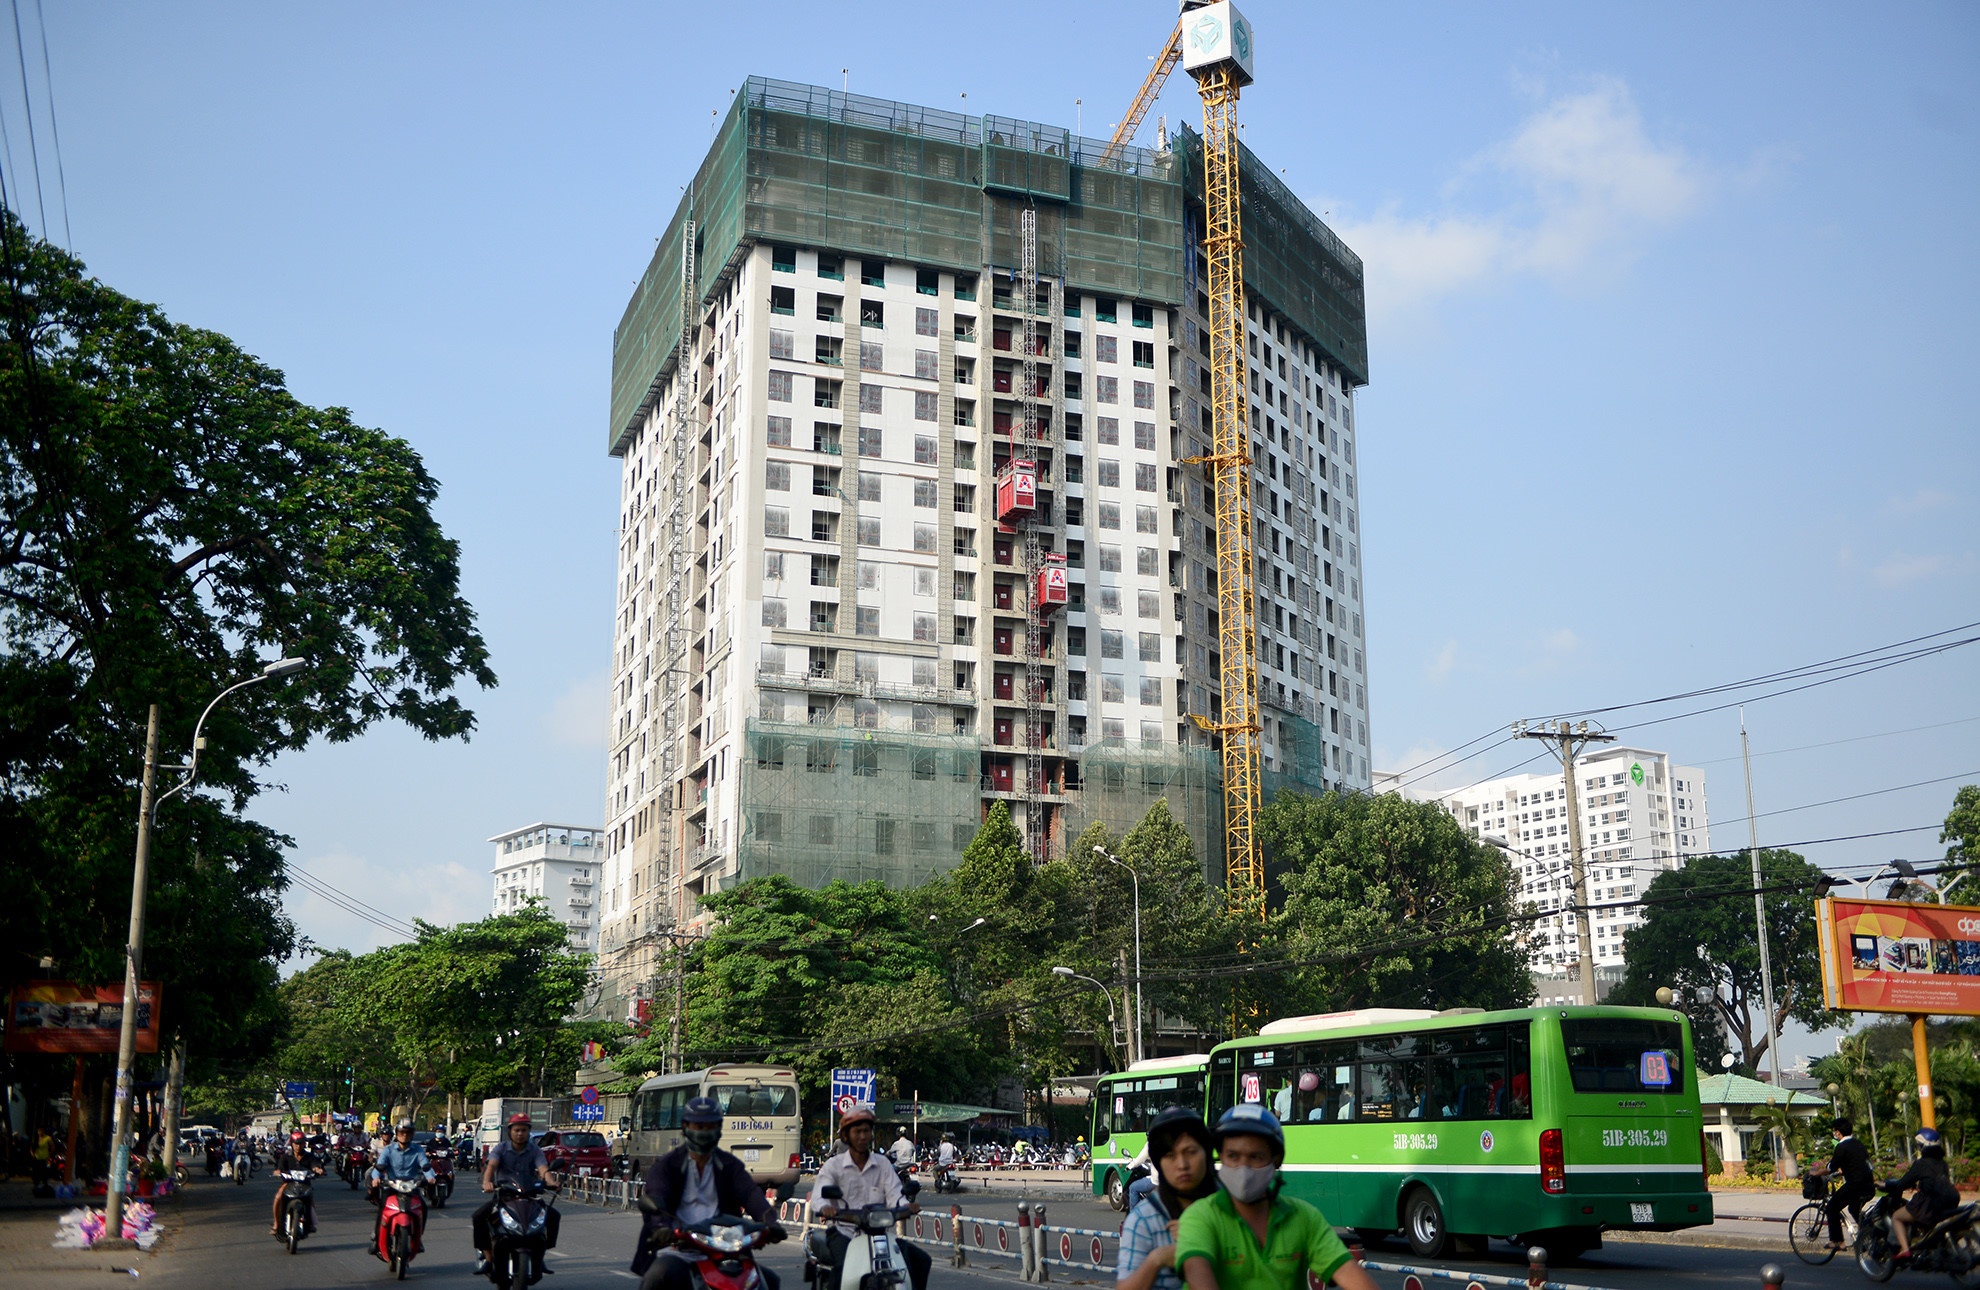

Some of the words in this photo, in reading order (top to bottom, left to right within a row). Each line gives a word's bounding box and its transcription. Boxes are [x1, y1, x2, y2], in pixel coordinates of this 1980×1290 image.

[1647, 1057, 1666, 1080] 03
[1247, 1080, 1258, 1099] 03
[1393, 1133, 1438, 1150] 51B-305.29
[1603, 1130, 1668, 1146] 51B-305.29
